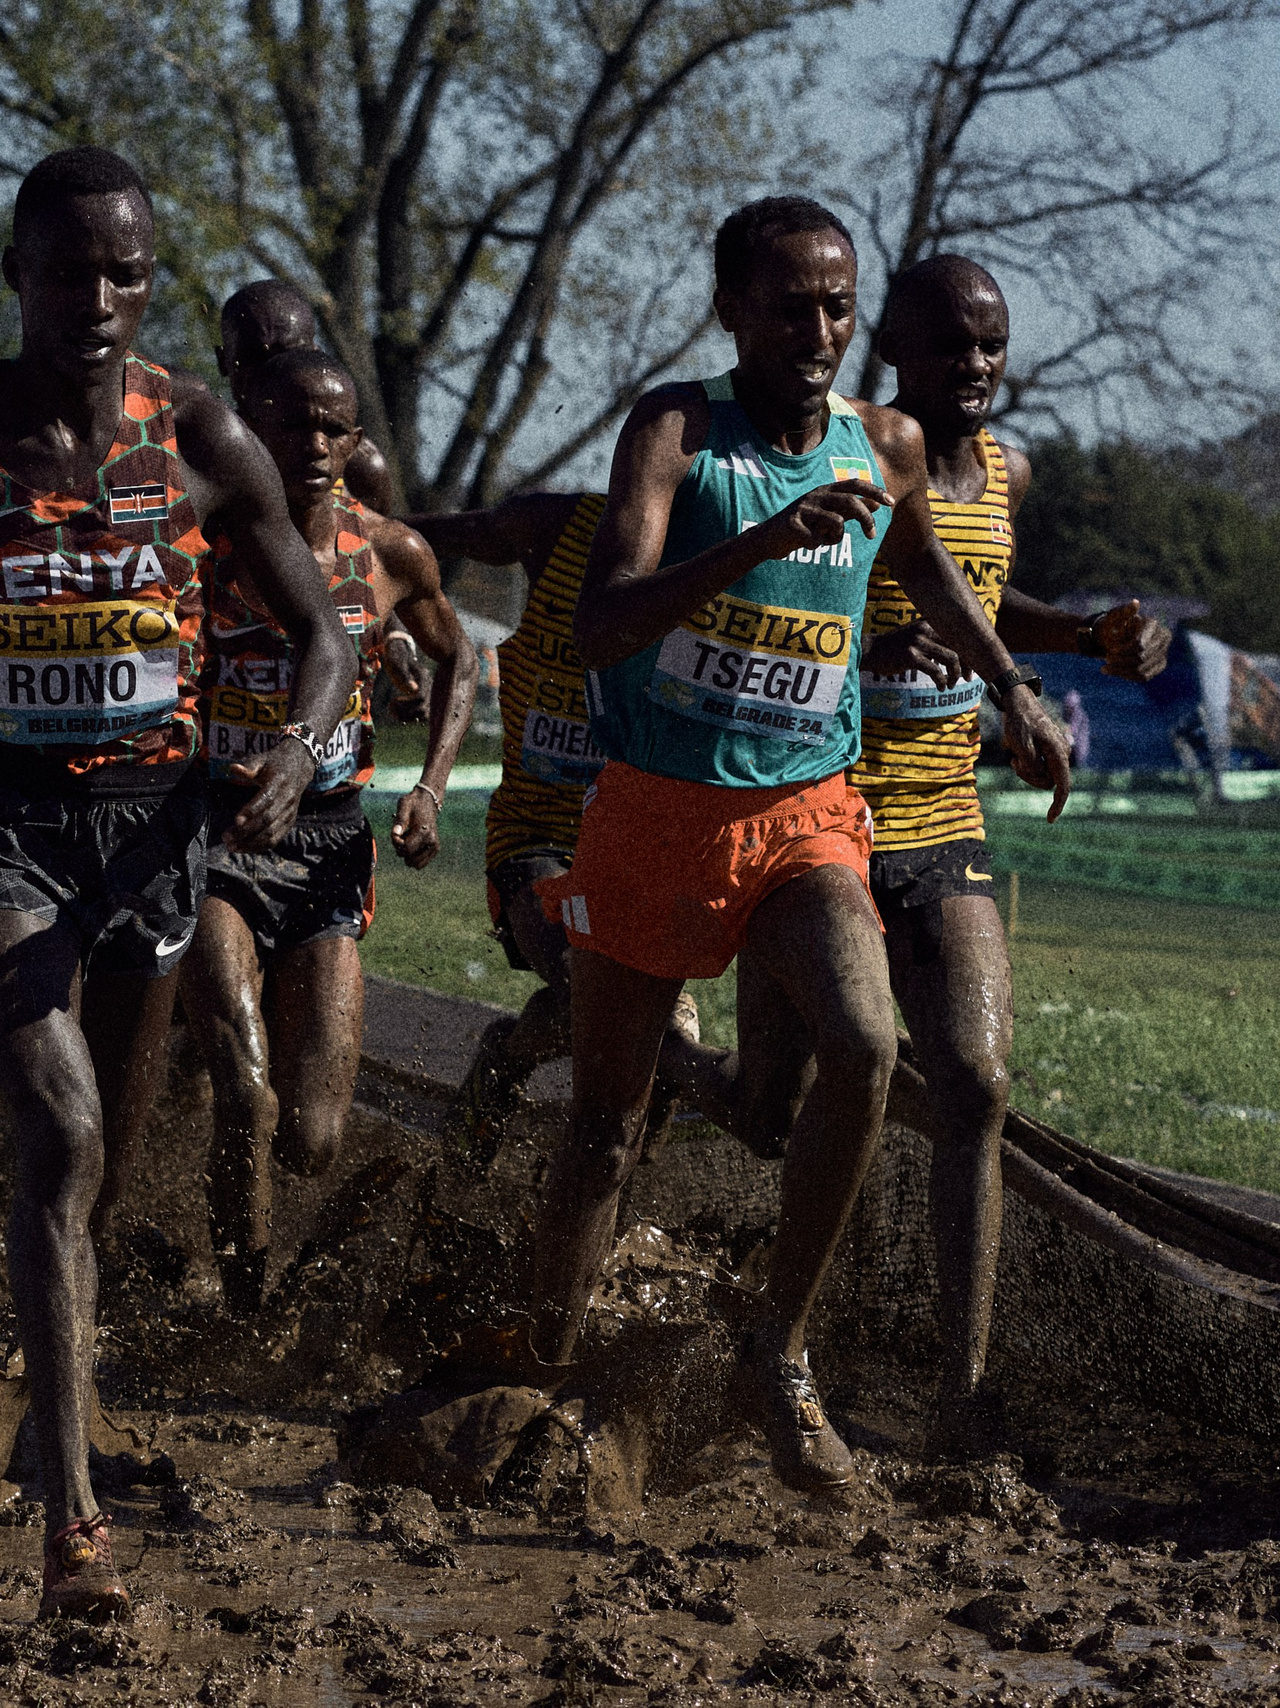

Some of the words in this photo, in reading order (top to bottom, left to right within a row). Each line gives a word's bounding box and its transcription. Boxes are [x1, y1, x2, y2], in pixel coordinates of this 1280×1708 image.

[688, 597, 846, 658] SEIKO
[8, 668, 137, 706] RONO
[692, 641, 821, 705] TSEGU
[701, 697, 798, 733] BELGRADE
[799, 718, 823, 735] 24
[910, 687, 973, 709] BELGRADE
[28, 714, 135, 734] BELGRADE
